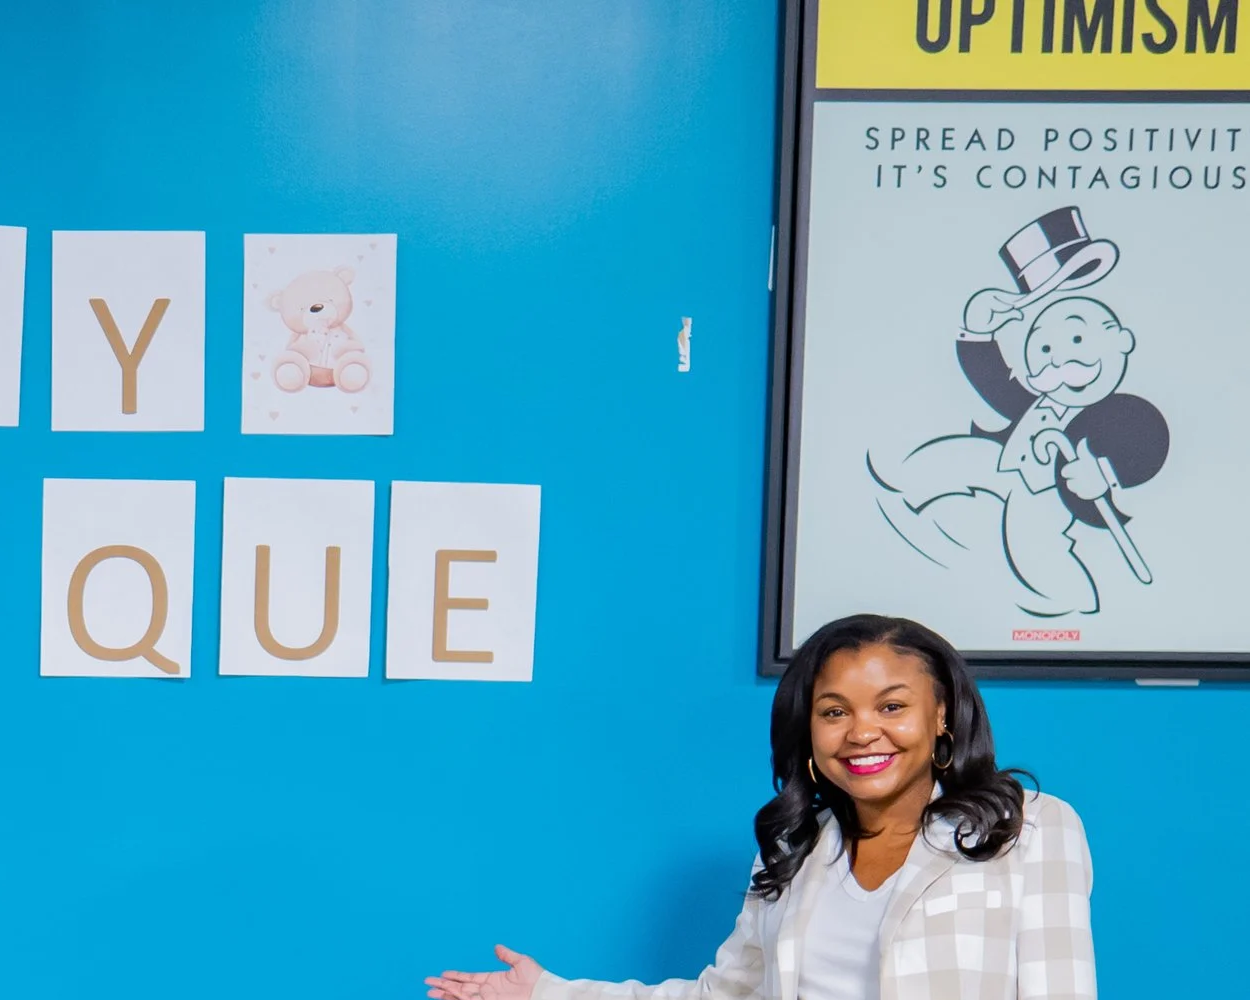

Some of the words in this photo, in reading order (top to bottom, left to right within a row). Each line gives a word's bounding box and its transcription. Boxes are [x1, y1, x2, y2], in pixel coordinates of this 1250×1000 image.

[916, 0, 1239, 54] OPTIMISM
[865, 126, 1016, 151] SPREAD
[876, 164, 948, 188] IT'S
[976, 165, 1247, 189] CONTAGIOUS
[1013, 630, 1079, 640] MONOPOLY
